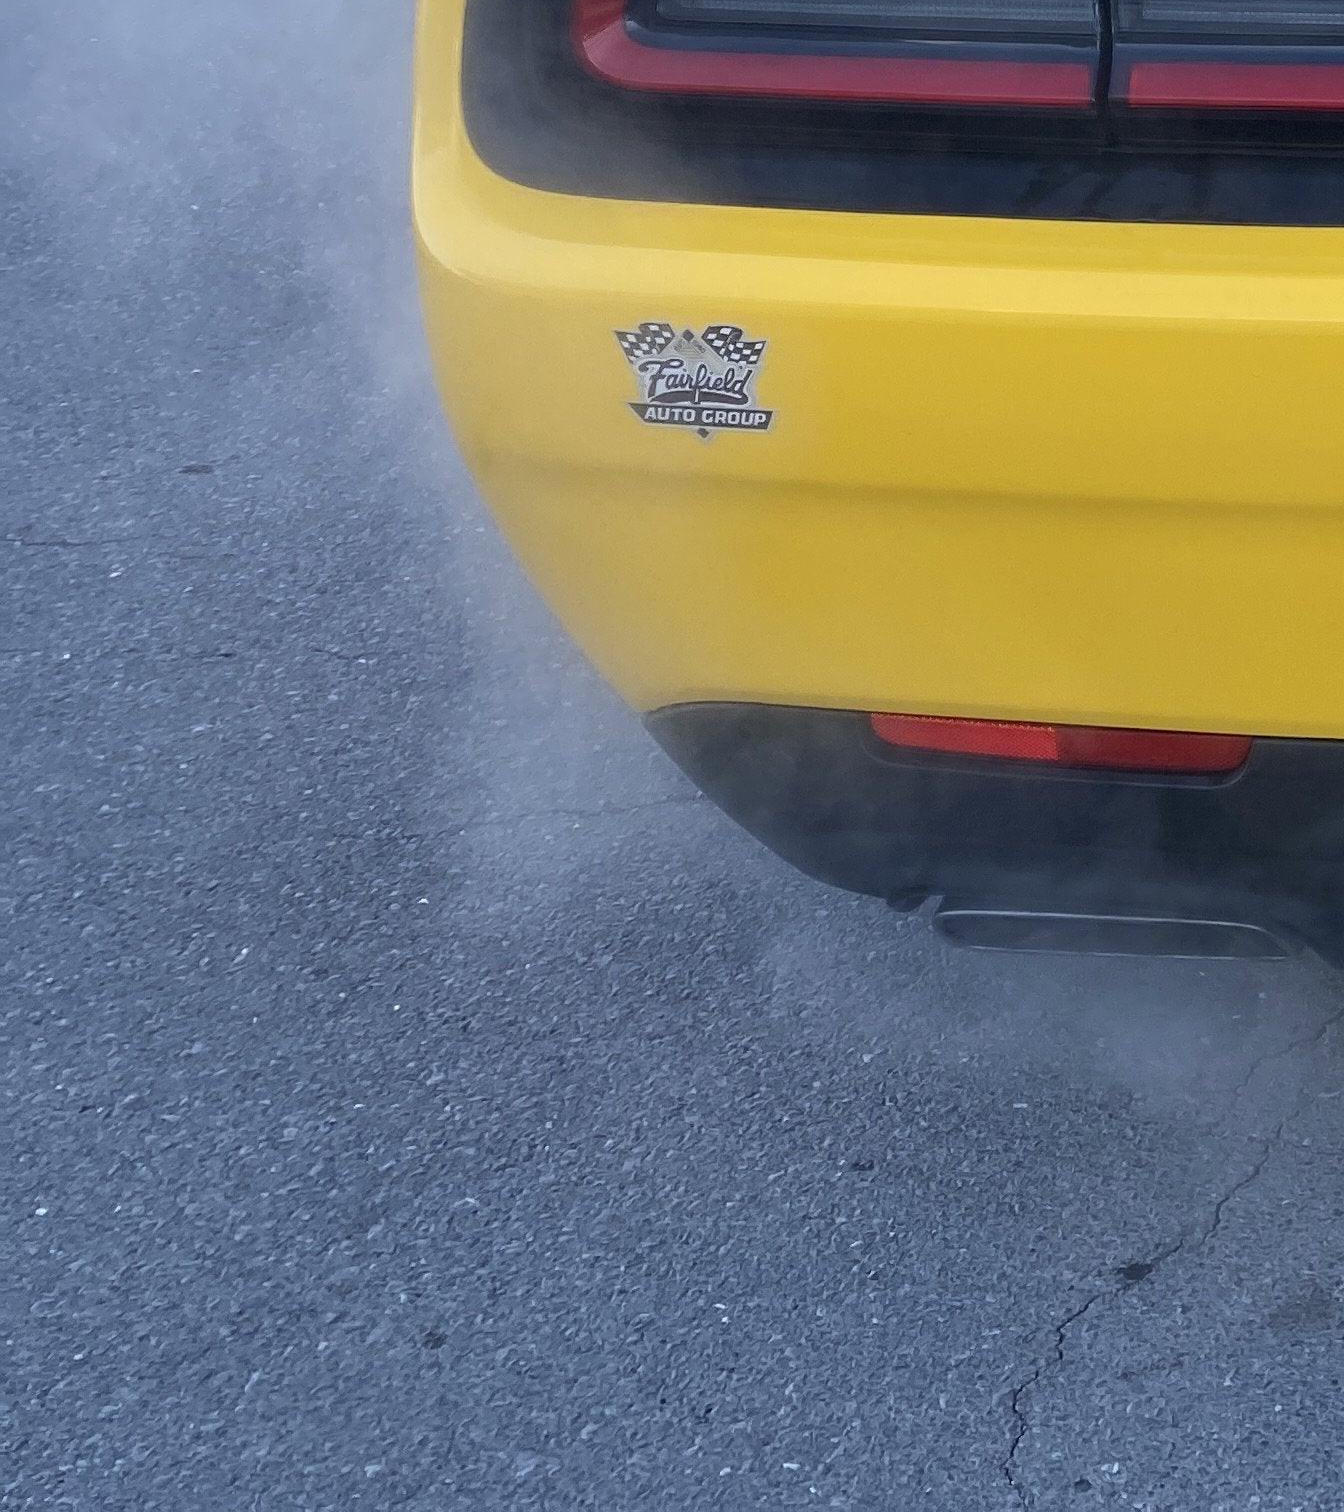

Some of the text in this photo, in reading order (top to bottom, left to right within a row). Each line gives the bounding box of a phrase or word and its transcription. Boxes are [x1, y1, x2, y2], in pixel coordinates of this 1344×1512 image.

[637, 358, 753, 399] Fairfield
[644, 407, 767, 426] AUTO GROUP
